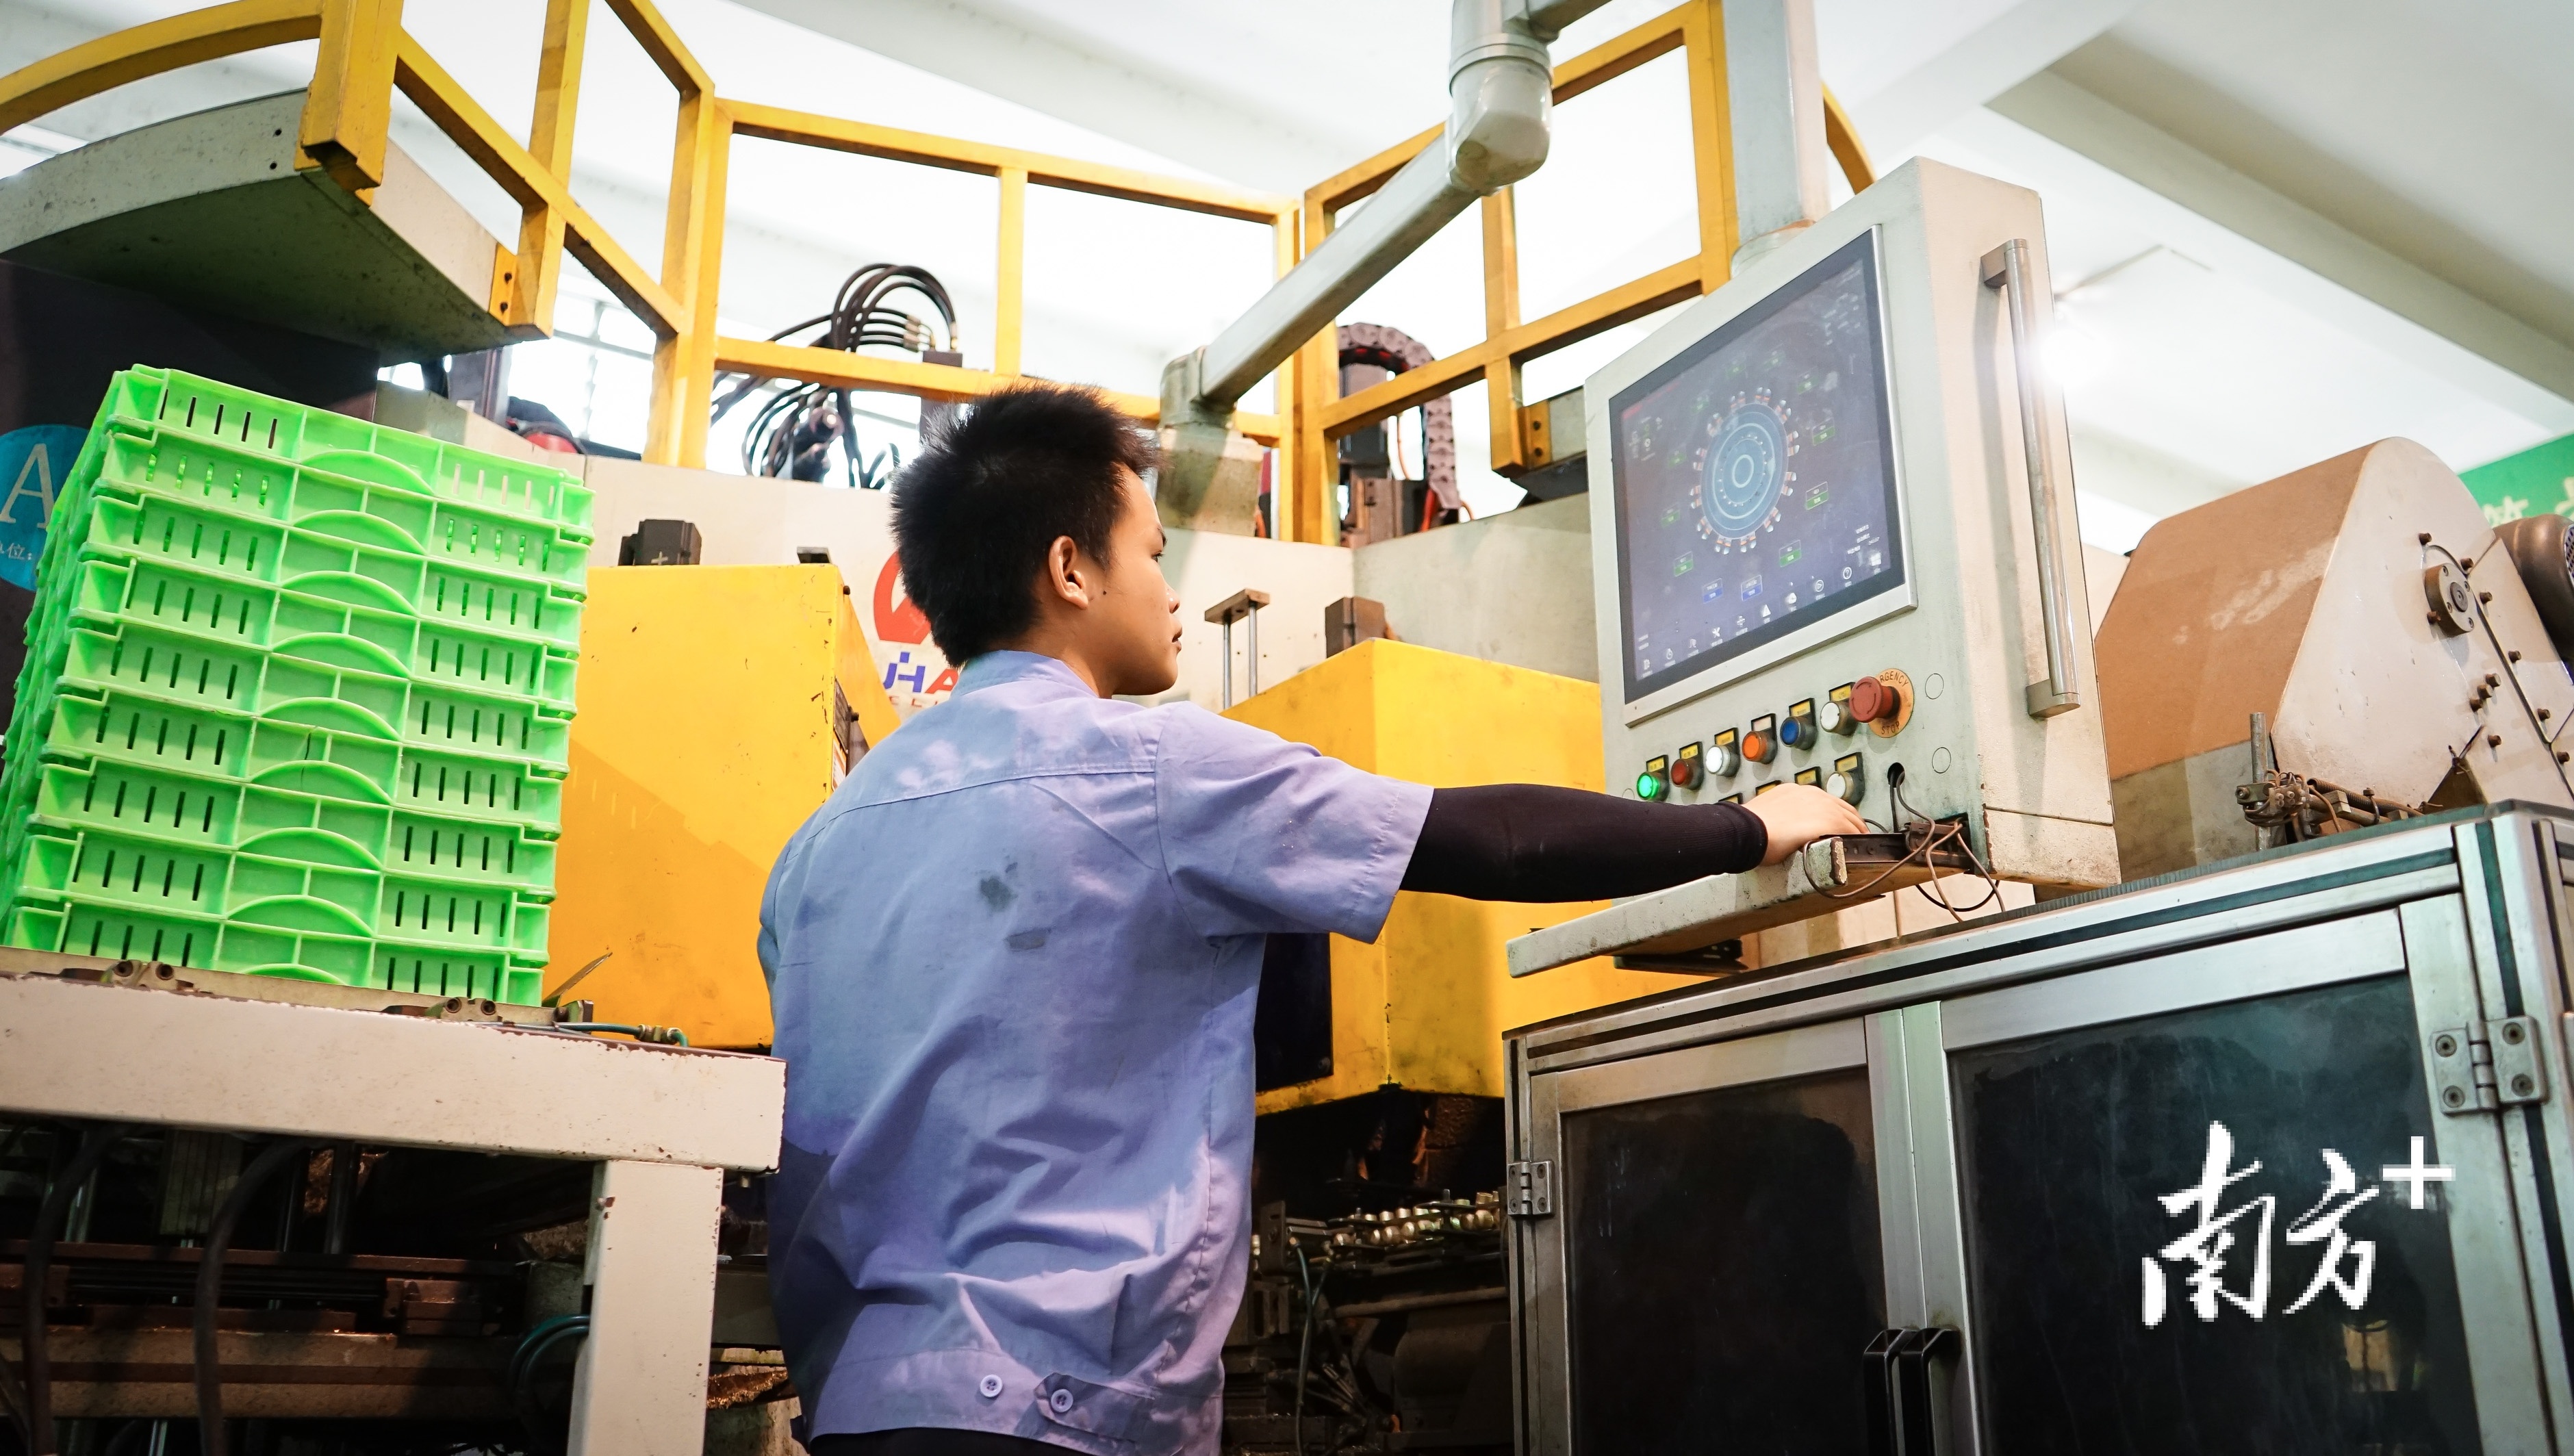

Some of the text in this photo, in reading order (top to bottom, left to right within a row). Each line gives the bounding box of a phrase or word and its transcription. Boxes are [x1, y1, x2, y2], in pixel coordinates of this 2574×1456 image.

[0, 444, 55, 529] A
[1880, 671, 1909, 687] RGENCY
[1881, 721, 1900, 735] STOP
